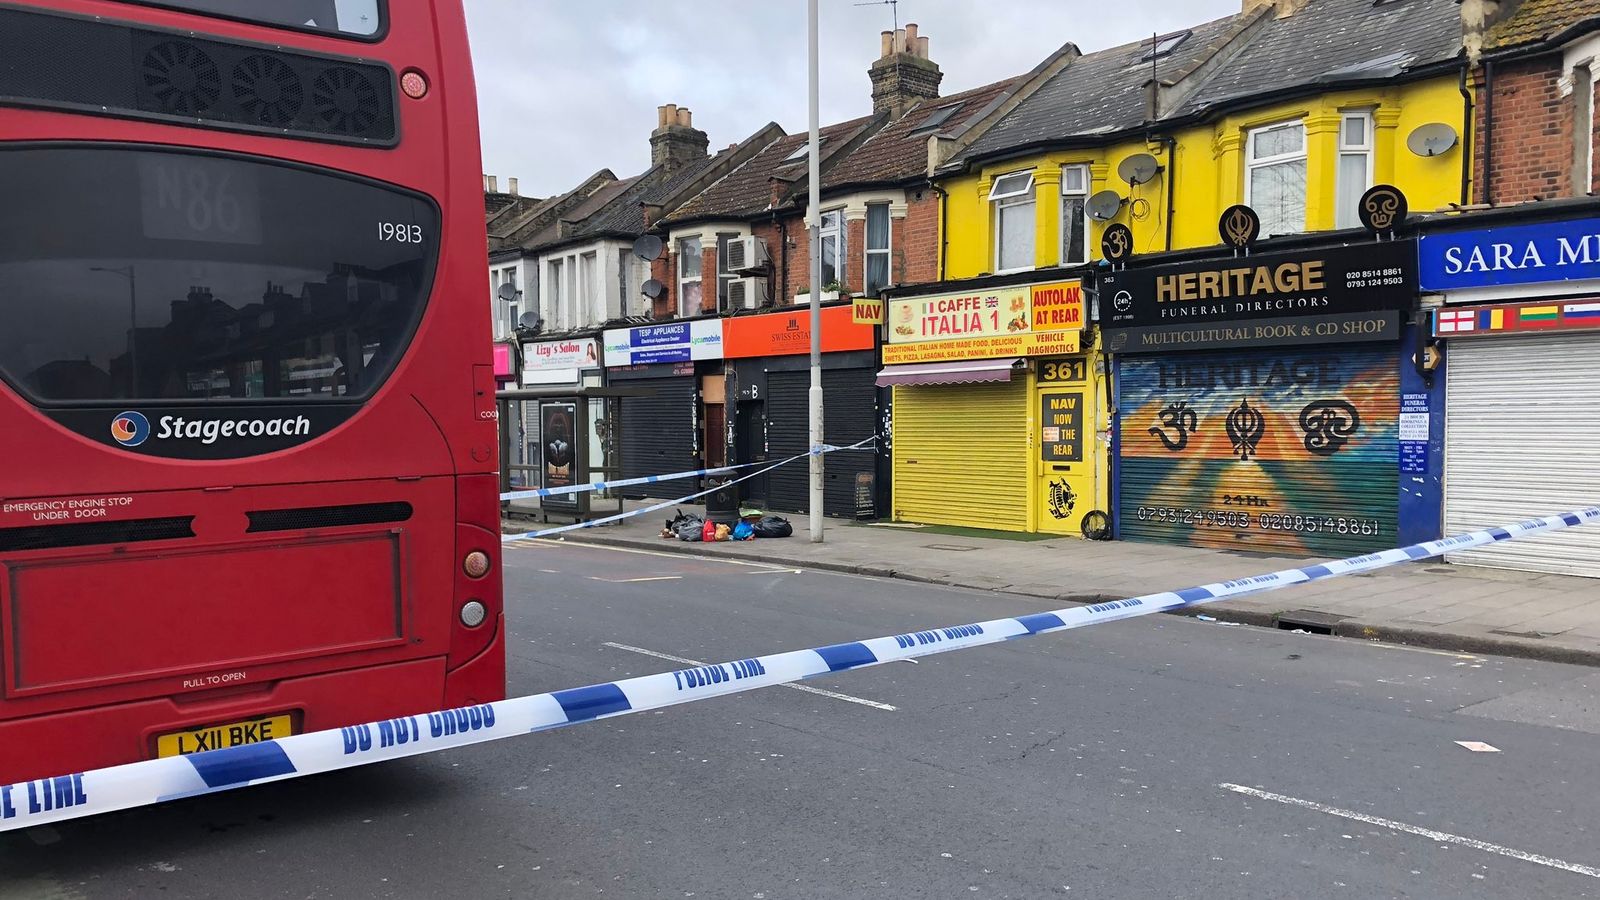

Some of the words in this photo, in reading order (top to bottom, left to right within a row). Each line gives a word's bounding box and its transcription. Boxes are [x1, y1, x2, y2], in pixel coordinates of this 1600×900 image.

[157, 166, 241, 233] N86
[379, 222, 422, 243] 19813
[1445, 240, 1545, 274] SARA
[1557, 234, 1600, 265] M
[1156, 260, 1326, 302] HERITAGE
[1362, 270, 1381, 278] 8514
[1383, 268, 1402, 276] 8861
[1346, 280, 1365, 288] 0793
[1368, 278, 1382, 286] 124
[1383, 277, 1403, 285] 9503
[938, 296, 981, 313] CAFFE
[1033, 286, 1080, 307] AUTOLAK
[855, 304, 881, 319] NAV
[1161, 304, 1227, 318] FUNERAL
[1235, 296, 1329, 312] DIRECTORS
[922, 312, 983, 336] ITALIA
[990, 310, 999, 330] 1
[1035, 310, 1049, 325] AT
[1051, 307, 1079, 323] REAR
[653, 325, 685, 335] APPLIANCES
[772, 333, 791, 342] SWISS
[792, 331, 811, 341] ESTA
[1036, 333, 1065, 342] VEHICLE
[1142, 328, 1251, 345] MULTICULTURAL
[1255, 325, 1297, 339] BOOK
[1301, 325, 1311, 337] &
[1315, 322, 1338, 336] CD
[1342, 319, 1386, 335] SHOP
[559, 342, 580, 353] Salon
[605, 343, 630, 352] Lycamobile
[691, 334, 721, 345] Lycamobile
[884, 346, 917, 354] TRADITIONAL
[991, 337, 1022, 346] DELICIOUS
[995, 347, 1018, 355] DRINKS
[1026, 344, 1074, 355] DIAGNOSTICS
[1044, 361, 1084, 380] 361
[1158, 358, 1342, 388] HERITAGE
[1050, 399, 1076, 409] NAV
[1053, 414, 1073, 425] NOW
[157, 414, 310, 444] Stagecoach
[1061, 429, 1076, 440] THE
[1053, 444, 1073, 456] REAR
[3, 501, 66, 513] EMERGENCY
[69, 498, 106, 509] ENGINE
[108, 497, 133, 506] STOP
[33, 511, 70, 520] UNDER
[75, 508, 107, 518] DOOR
[1137, 507, 1250, 528] 07931249503
[1259, 513, 1379, 536] 02085148861
[183, 679, 205, 688] PULL
[207, 676, 220, 684] TO
[222, 672, 246, 682] OPEN
[178, 730, 222, 756] LX11
[229, 721, 273, 745] BKE
